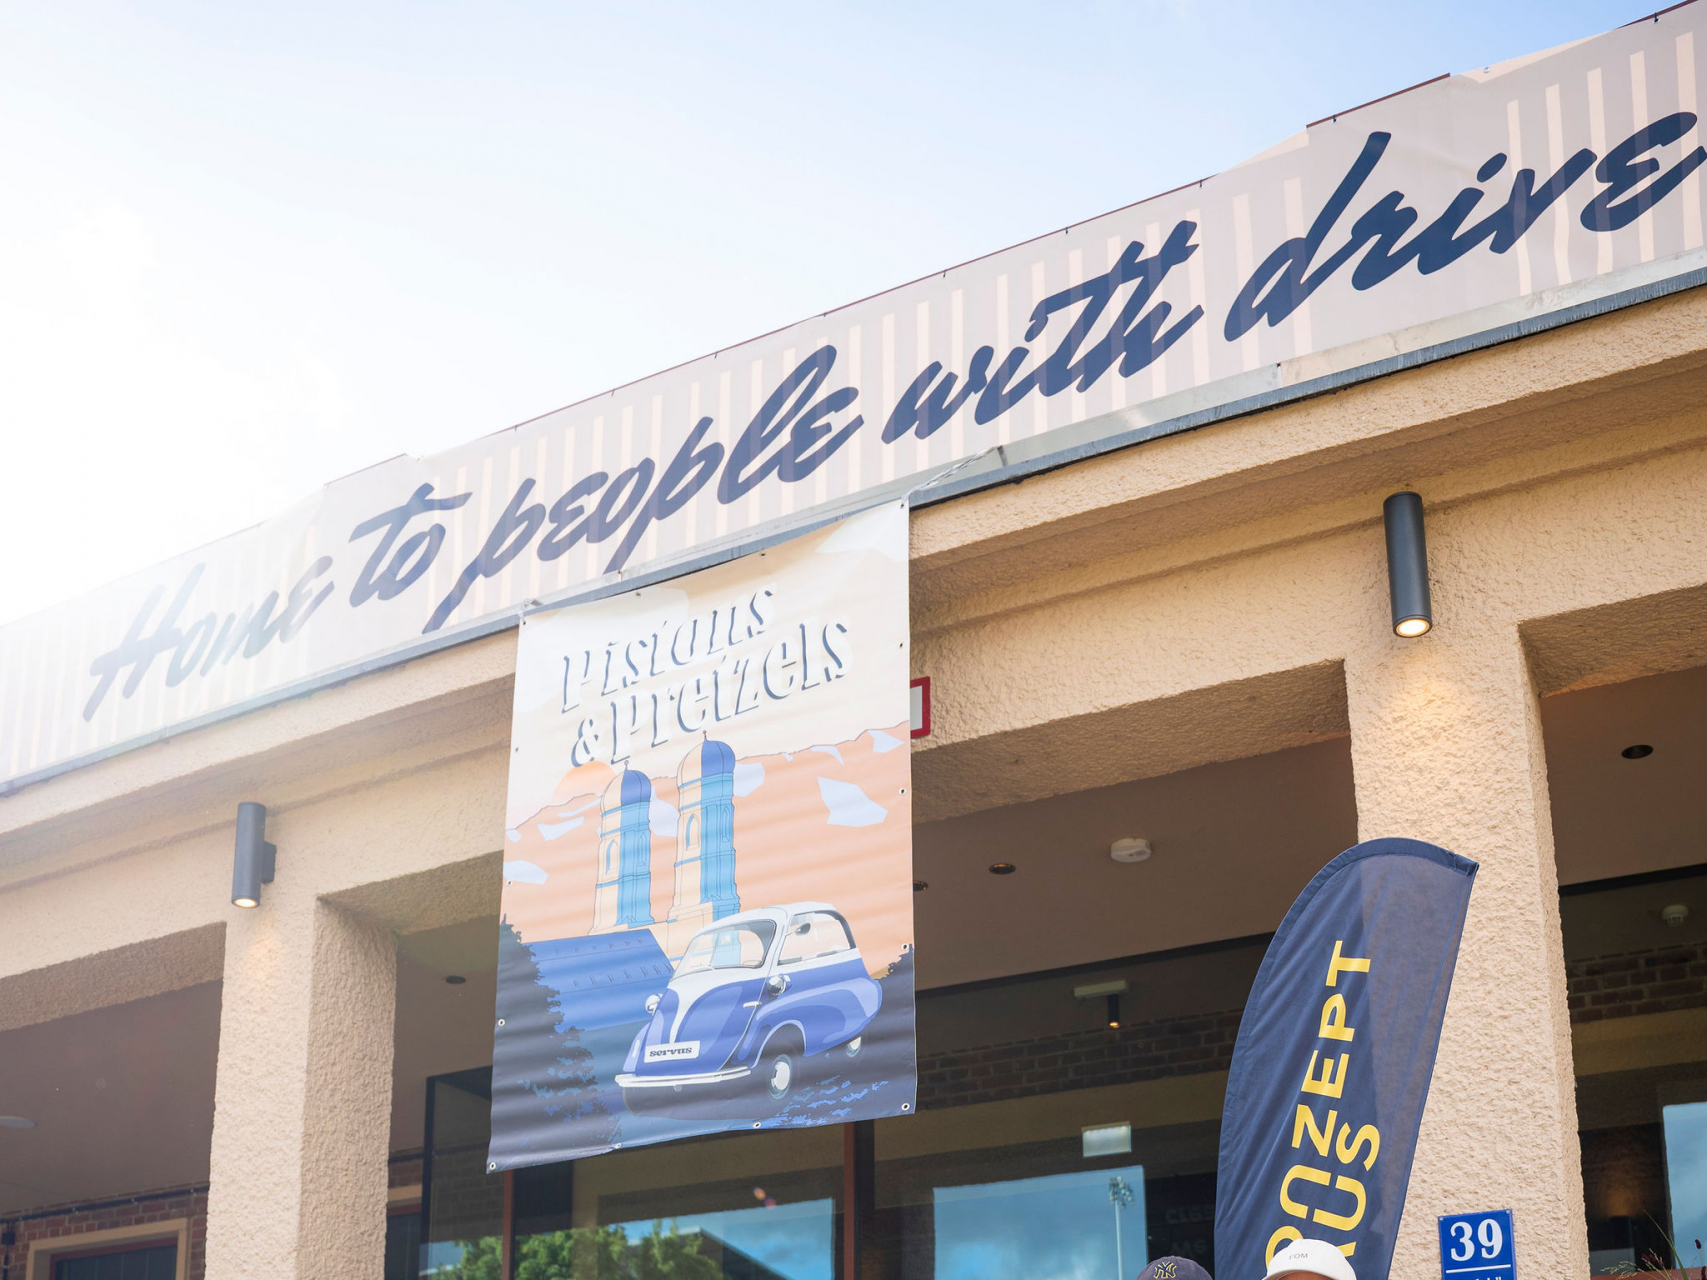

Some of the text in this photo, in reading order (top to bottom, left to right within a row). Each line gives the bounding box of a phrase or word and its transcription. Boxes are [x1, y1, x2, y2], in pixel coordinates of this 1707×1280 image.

[83, 112, 1707, 723] Home to people with drive
[649, 1047, 692, 1057] servus
[1450, 1218, 1503, 1262] 39
[1153, 1260, 1178, 1280] NY
